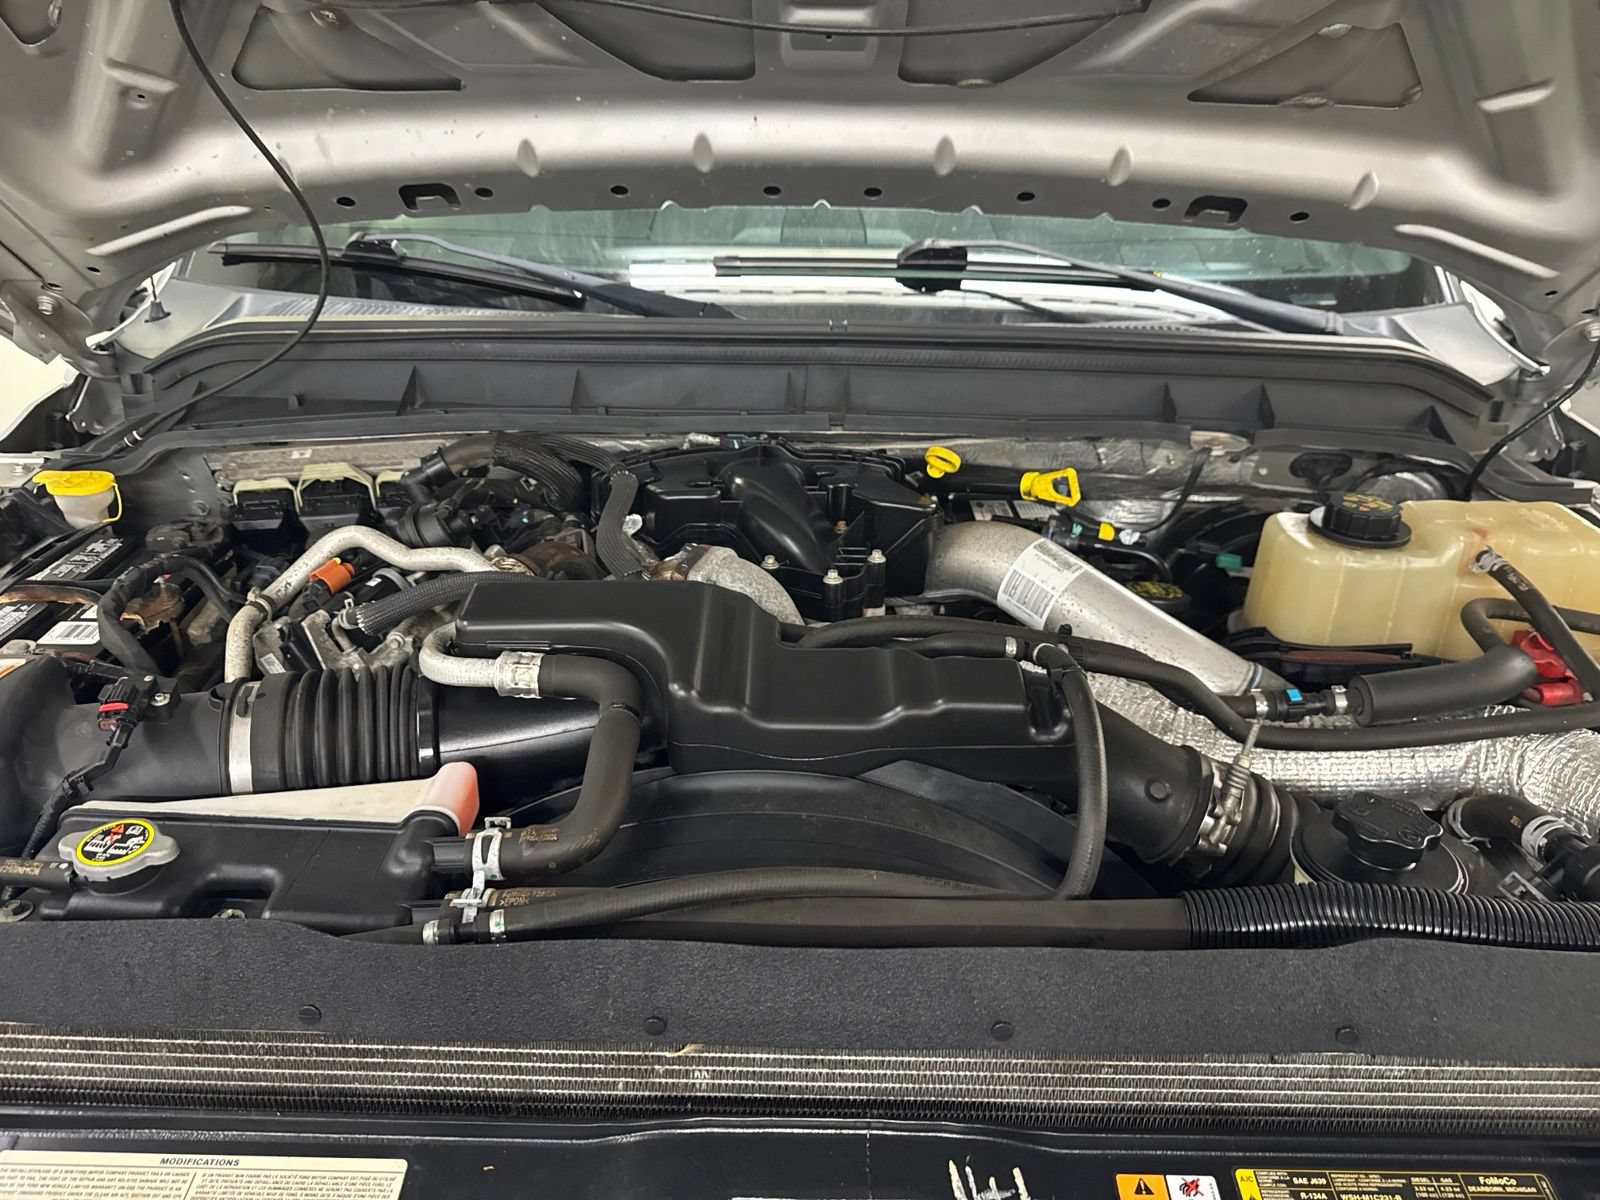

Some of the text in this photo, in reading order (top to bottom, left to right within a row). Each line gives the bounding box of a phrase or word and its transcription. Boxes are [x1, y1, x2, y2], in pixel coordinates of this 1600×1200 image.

[159, 1157, 240, 1167] MODIFICATIONS
[1292, 1177, 1309, 1185] SAE
[1310, 1177, 1327, 1185] J639
[1478, 1176, 1518, 1186] FoMoCo
[1299, 1192, 1328, 1200] R-134A
